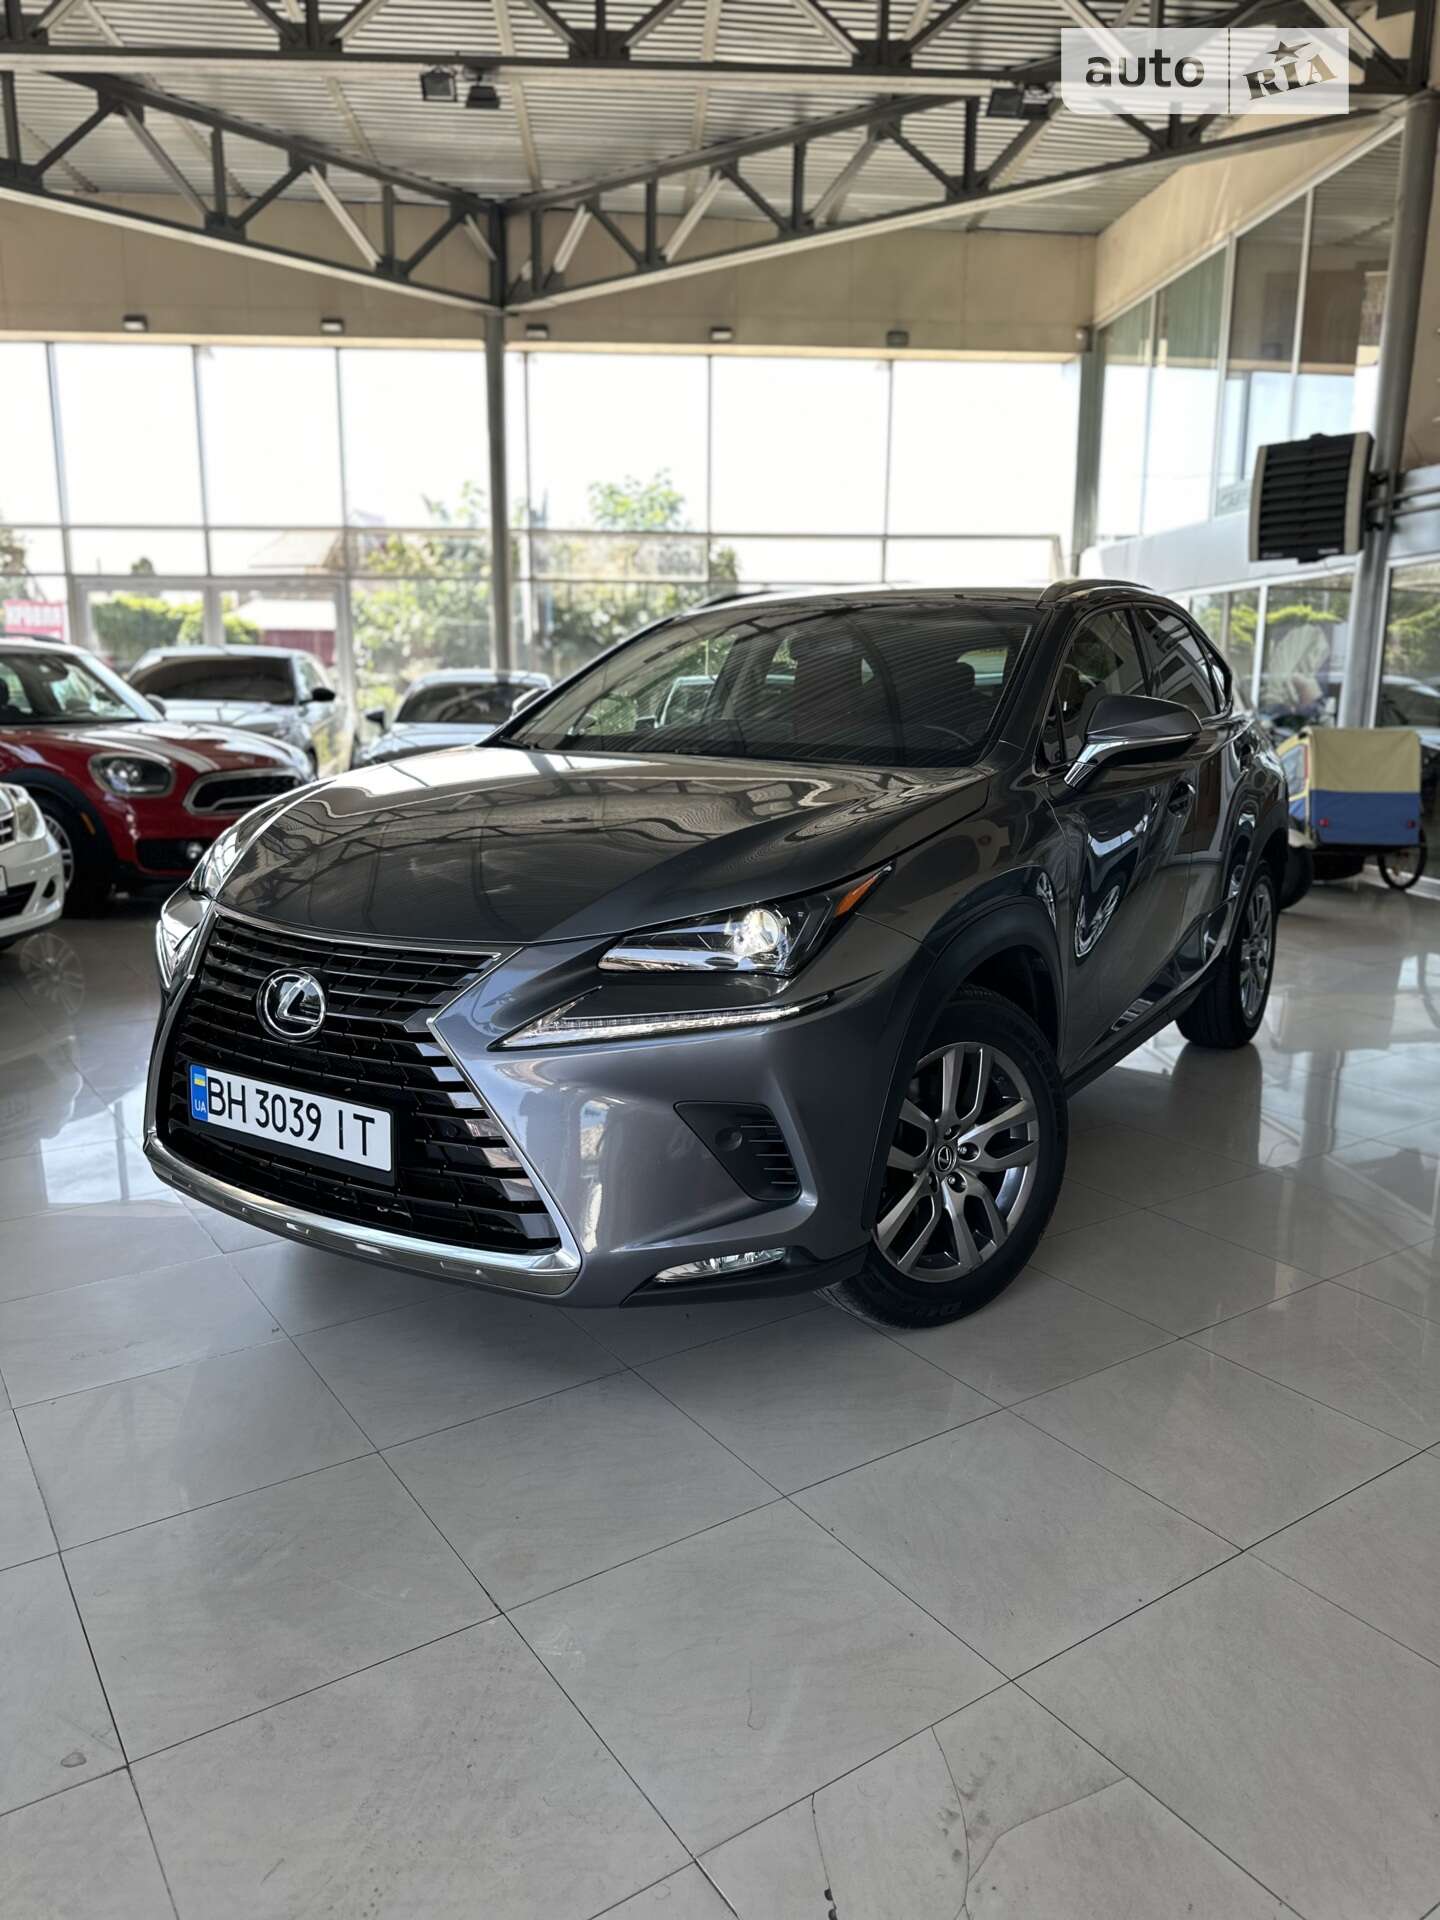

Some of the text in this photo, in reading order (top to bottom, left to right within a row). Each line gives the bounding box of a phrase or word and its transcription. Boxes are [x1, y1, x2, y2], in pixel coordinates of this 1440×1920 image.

[194, 1098, 207, 1113] UA
[207, 1076, 247, 1123] BH
[255, 1088, 321, 1142] 3039
